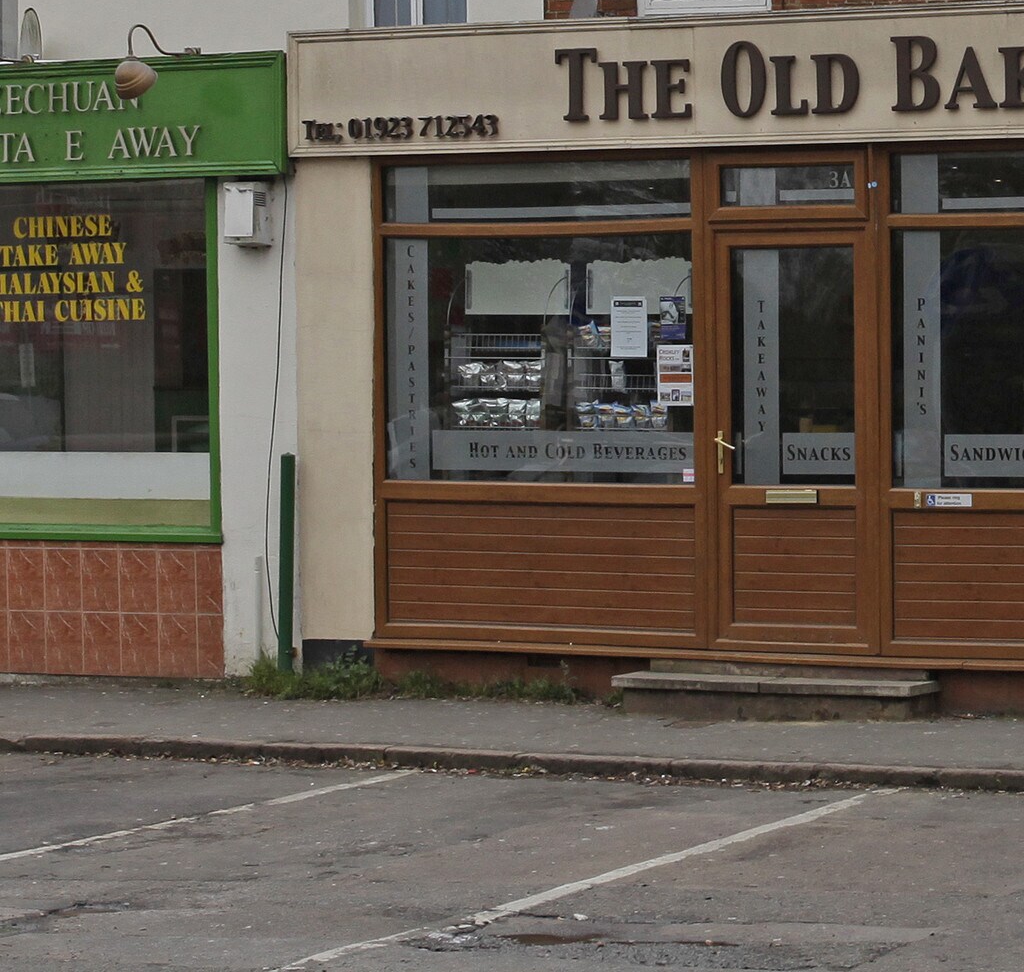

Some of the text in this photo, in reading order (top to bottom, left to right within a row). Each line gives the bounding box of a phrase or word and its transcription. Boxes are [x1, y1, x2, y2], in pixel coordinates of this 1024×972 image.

[554, 47, 693, 123] THE
[720, 40, 860, 118] OLD
[0, 79, 139, 115] ECHUA
[347, 116, 414, 141] 01923
[418, 114, 499, 138] 712543
[108, 125, 200, 159] AWAY
[829, 170, 851, 188] 3A
[13, 215, 112, 238] CHINESE
[0, 242, 126, 267] TAKE AWAY
[126, 269, 144, 293] &
[0, 298, 146, 323] HAI CUISINE
[756, 300, 768, 433] TAKEAWAY
[468, 442, 688, 461] HOT AND COLD BEVERAGES
[786, 443, 851, 462] SNACKS
